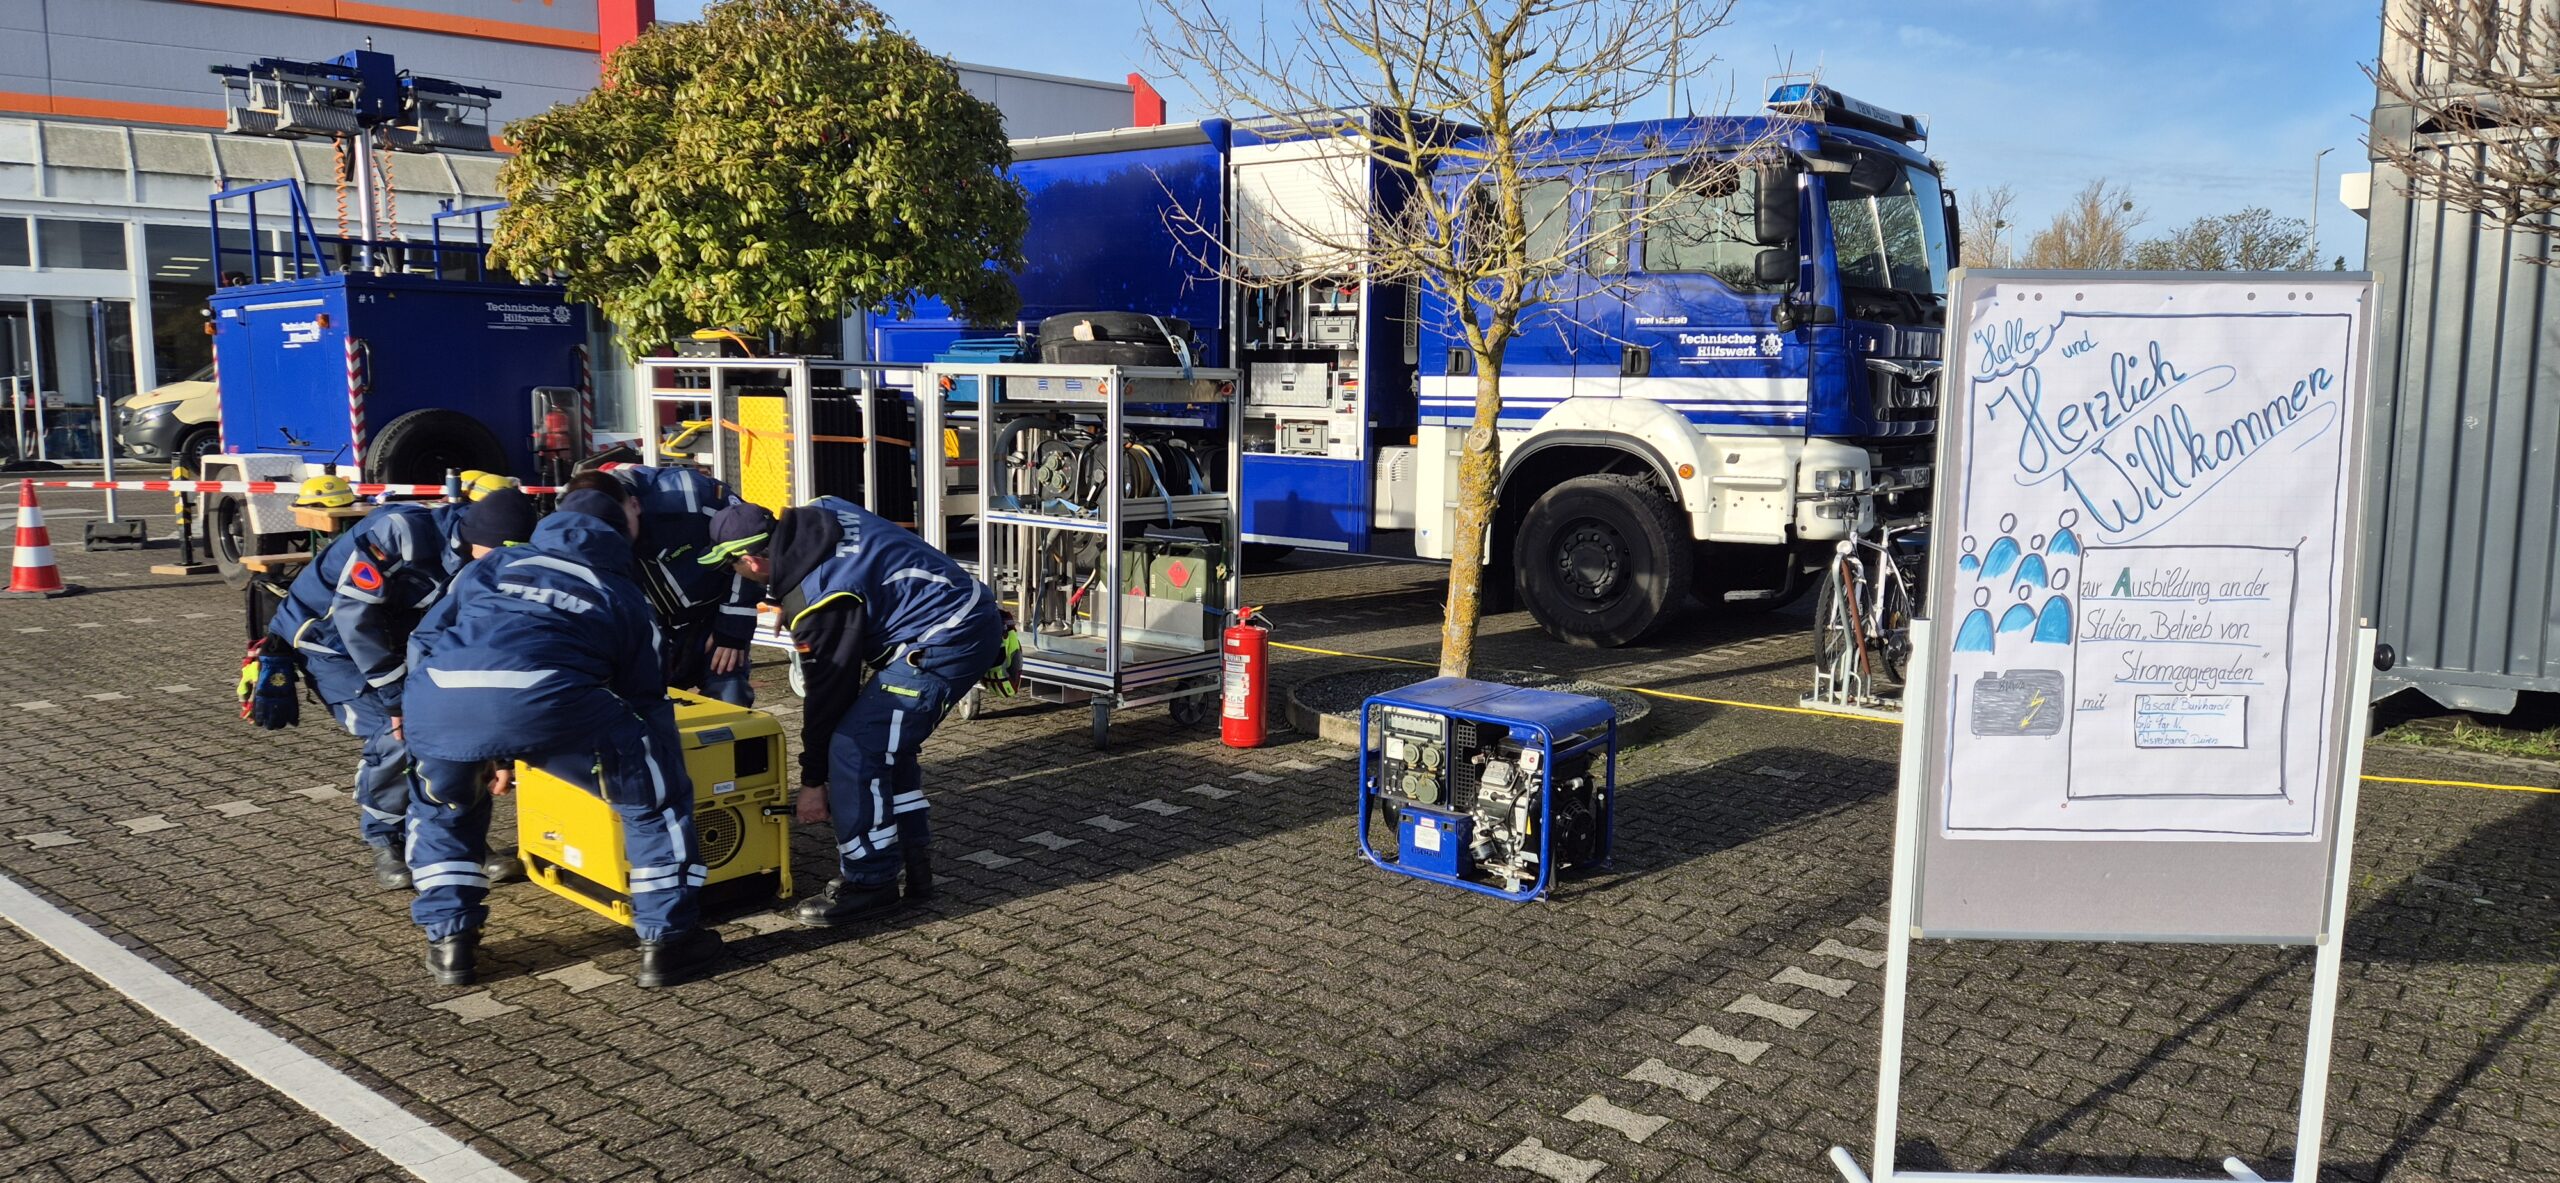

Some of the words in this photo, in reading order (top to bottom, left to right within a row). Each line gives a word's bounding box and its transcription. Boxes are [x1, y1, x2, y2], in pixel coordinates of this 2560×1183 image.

[485, 302, 550, 313] Technisches
[503, 313, 551, 323] Hilfswerk
[1679, 333, 1757, 344] Technisches
[1697, 346, 1757, 356] Hilfswerk
[1974, 317, 2042, 372] Hallo
[2062, 331, 2099, 358] und
[1985, 341, 2187, 474] Herzlich
[2063, 367, 2334, 533] Willkommen
[836, 509, 861, 558] THW
[497, 582, 593, 614] THW
[2081, 581, 2102, 597] zur
[2110, 567, 2210, 605] Ausbildung
[2219, 582, 2242, 597] an
[2244, 568, 2269, 597] der
[2080, 608, 2142, 640] Station
[2221, 622, 2249, 639] von
[2082, 693, 2107, 708] mit
[2139, 695, 2179, 711] Pascal
